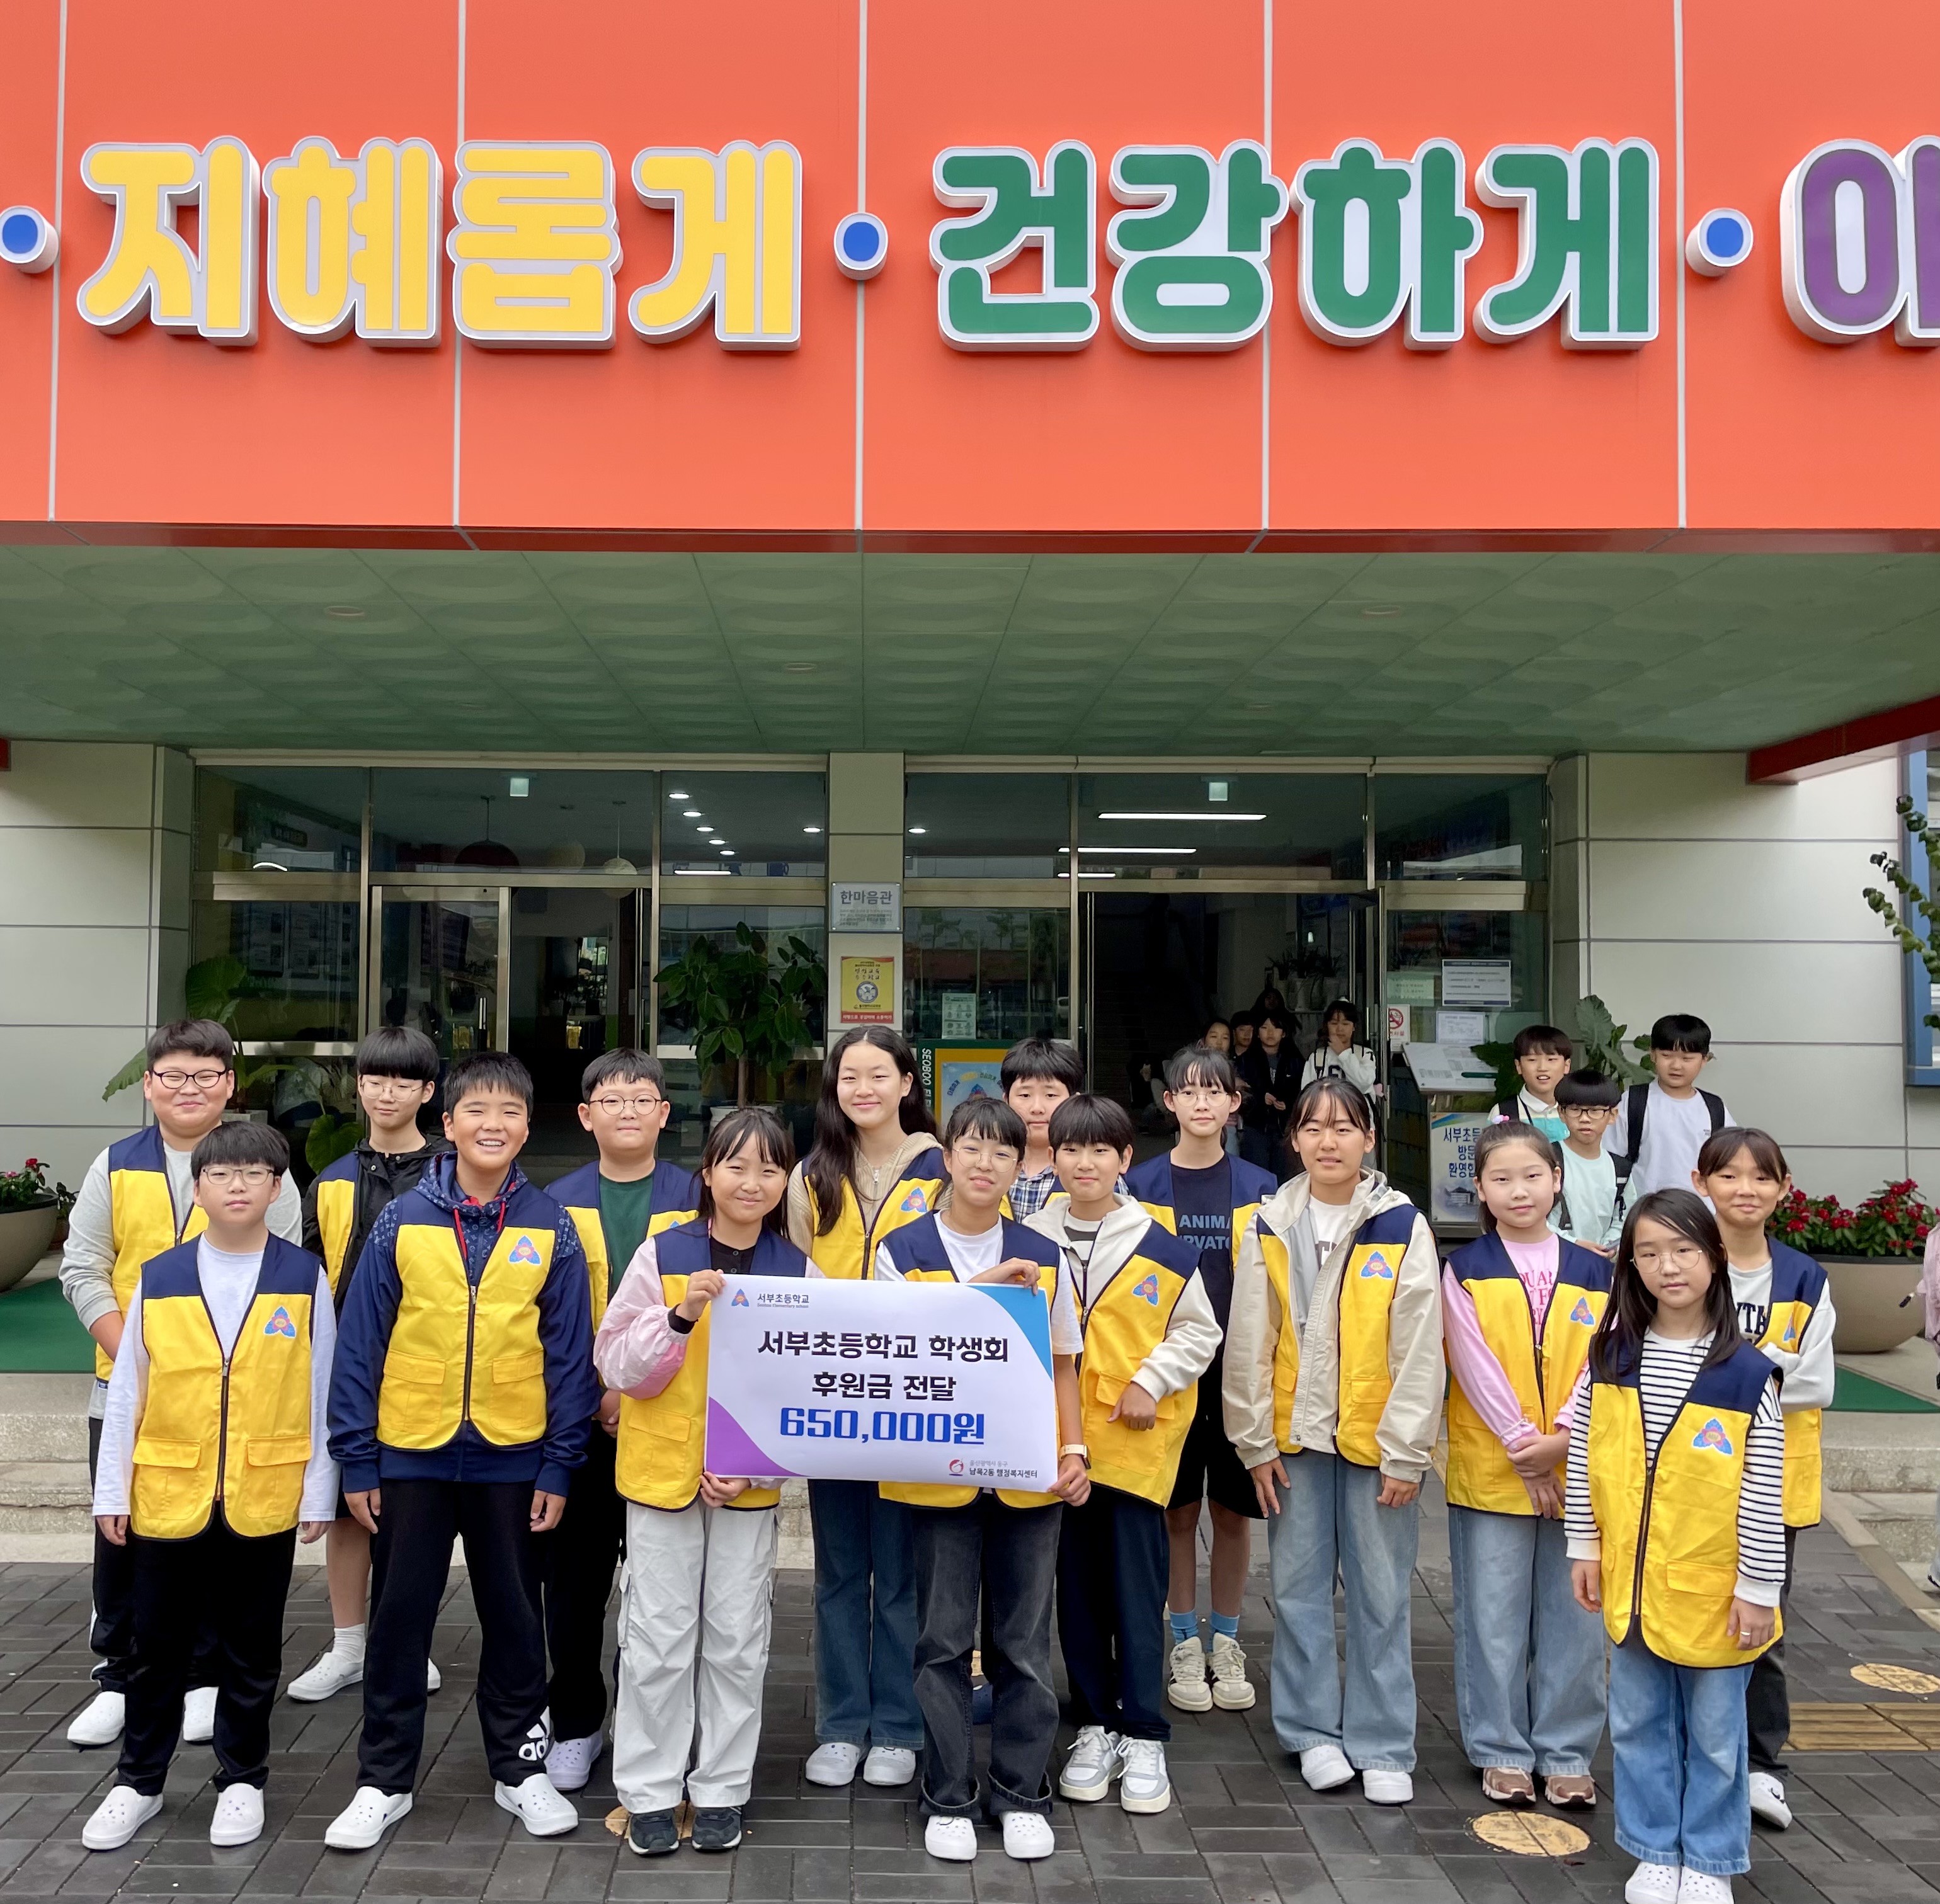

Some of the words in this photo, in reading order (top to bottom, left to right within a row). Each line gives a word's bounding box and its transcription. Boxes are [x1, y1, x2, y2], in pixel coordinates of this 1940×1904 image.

[77, 135, 803, 348] 지혜롭게
[930, 138, 1659, 350] 건강하게
[840, 890, 892, 904] 한마음관
[922, 1047, 932, 1085] SEOBOO
[1443, 1127, 1481, 1143] 서부초등
[1449, 1163, 1475, 1178] 환영합
[757, 1293, 809, 1304] 서부초등학교
[757, 1330, 918, 1359] 서부초등학교
[928, 1335, 1008, 1362] 학생회
[812, 1371, 893, 1399] 후원금
[903, 1375, 957, 1401] 전달
[780, 1407, 984, 1445] 650,000원
[996, 1468, 1038, 1478] 행정복지센터
